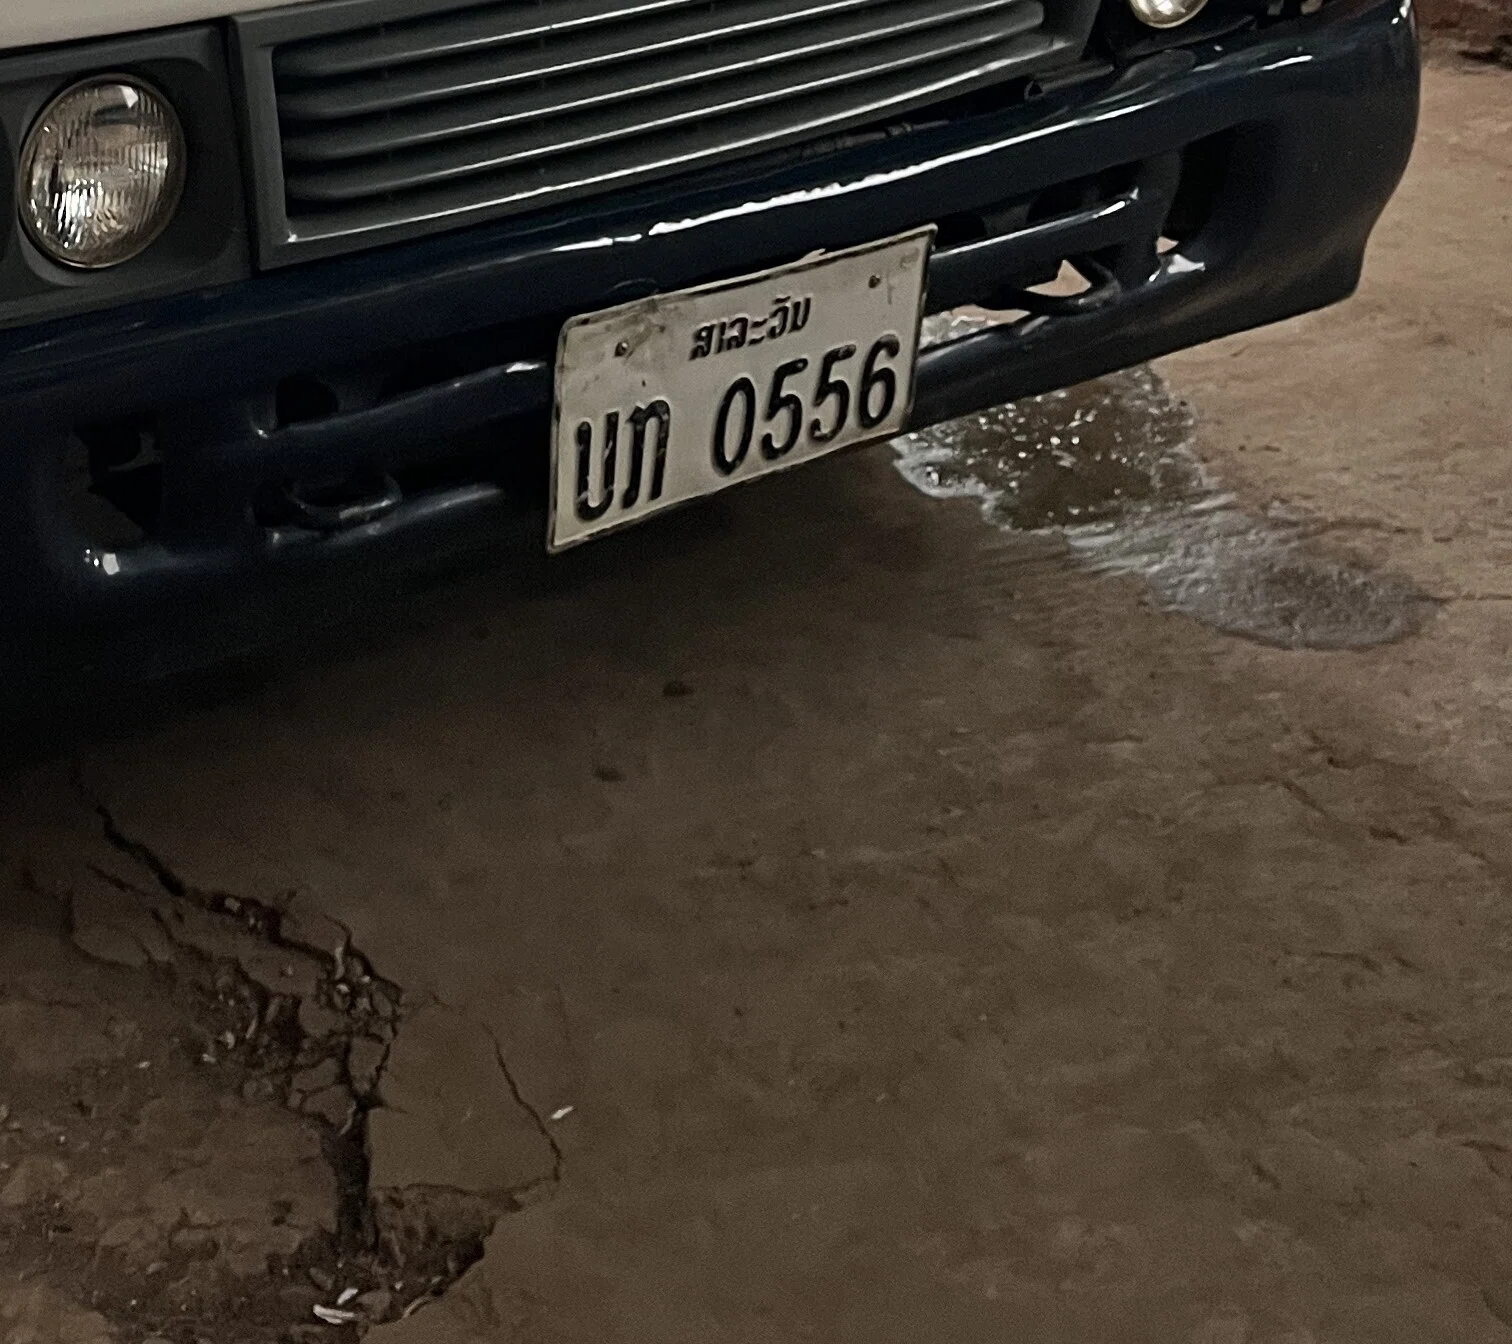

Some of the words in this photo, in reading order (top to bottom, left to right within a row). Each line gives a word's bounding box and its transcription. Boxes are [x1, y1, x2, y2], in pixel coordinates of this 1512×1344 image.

[688, 295, 812, 361] ສາລະວັນ
[711, 333, 901, 477] 0556
